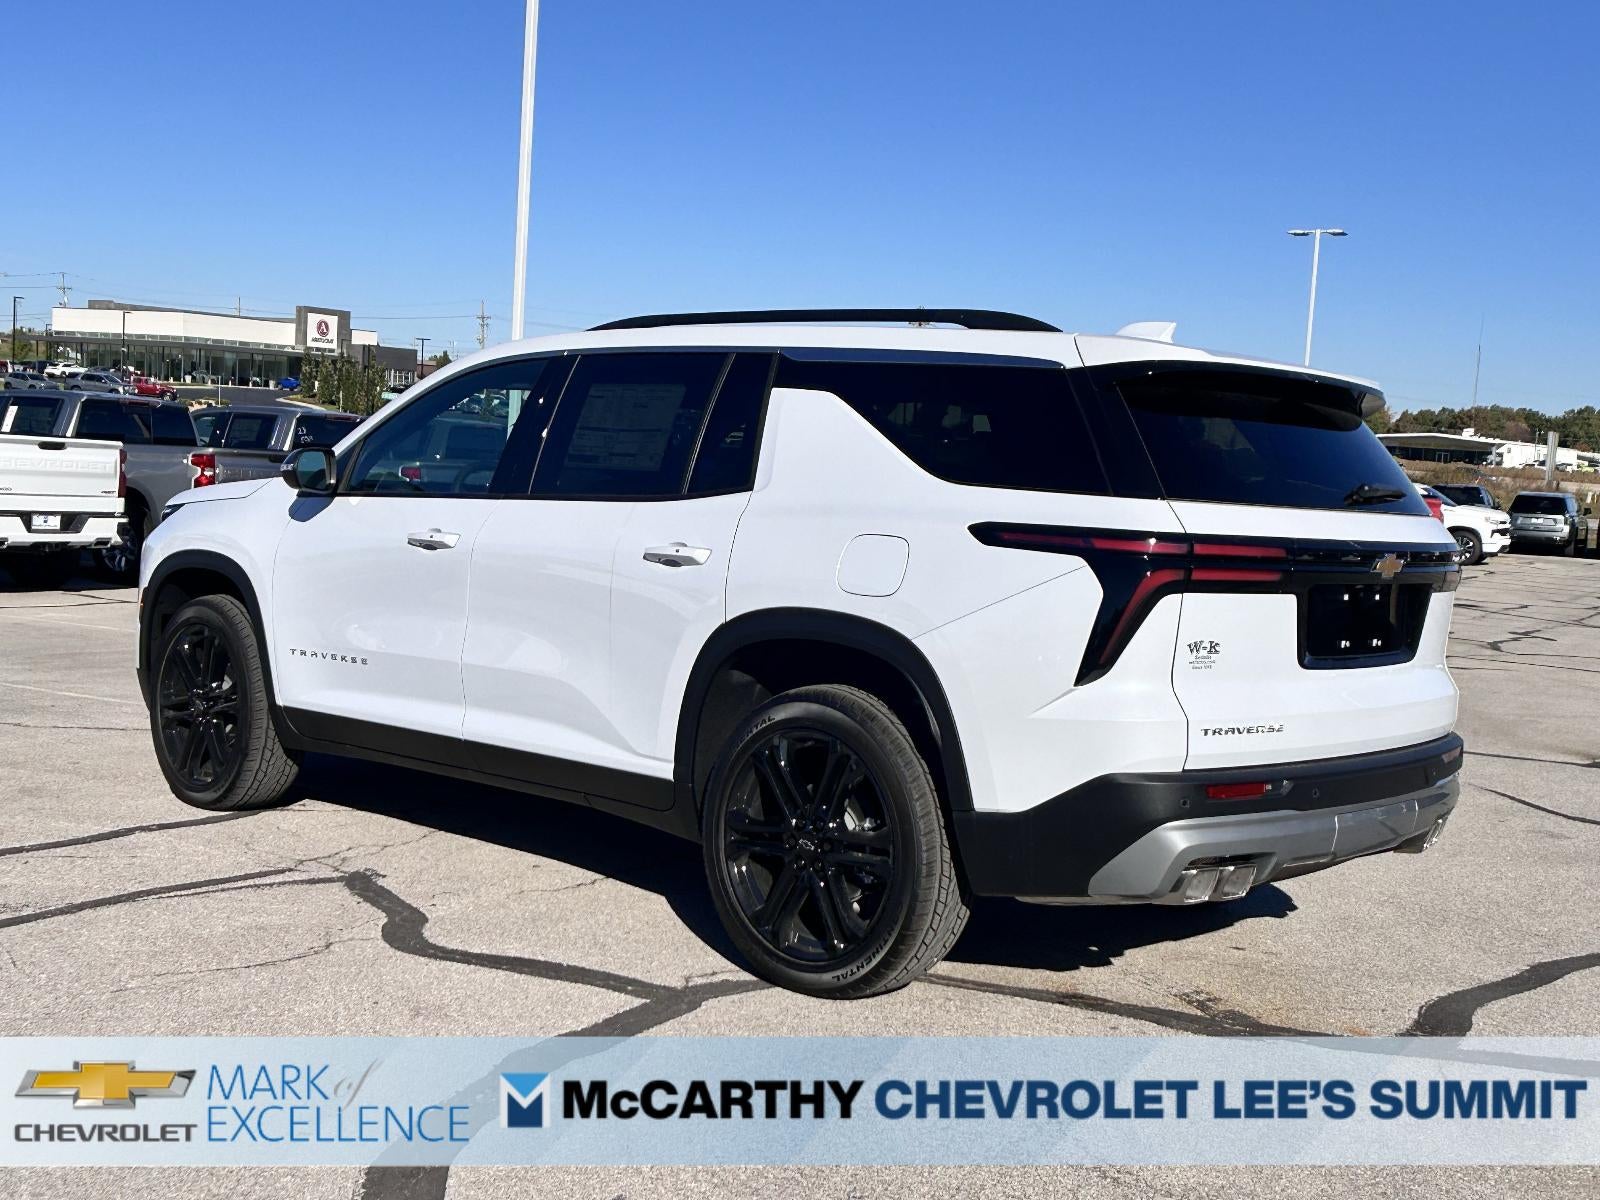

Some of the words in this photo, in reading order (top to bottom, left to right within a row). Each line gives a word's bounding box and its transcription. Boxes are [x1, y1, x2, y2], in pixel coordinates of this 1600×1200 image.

[0, 457, 112, 473] HEVROLET
[289, 648, 368, 665] TRAVERSE
[1201, 724, 1284, 737] TRAVERSE
